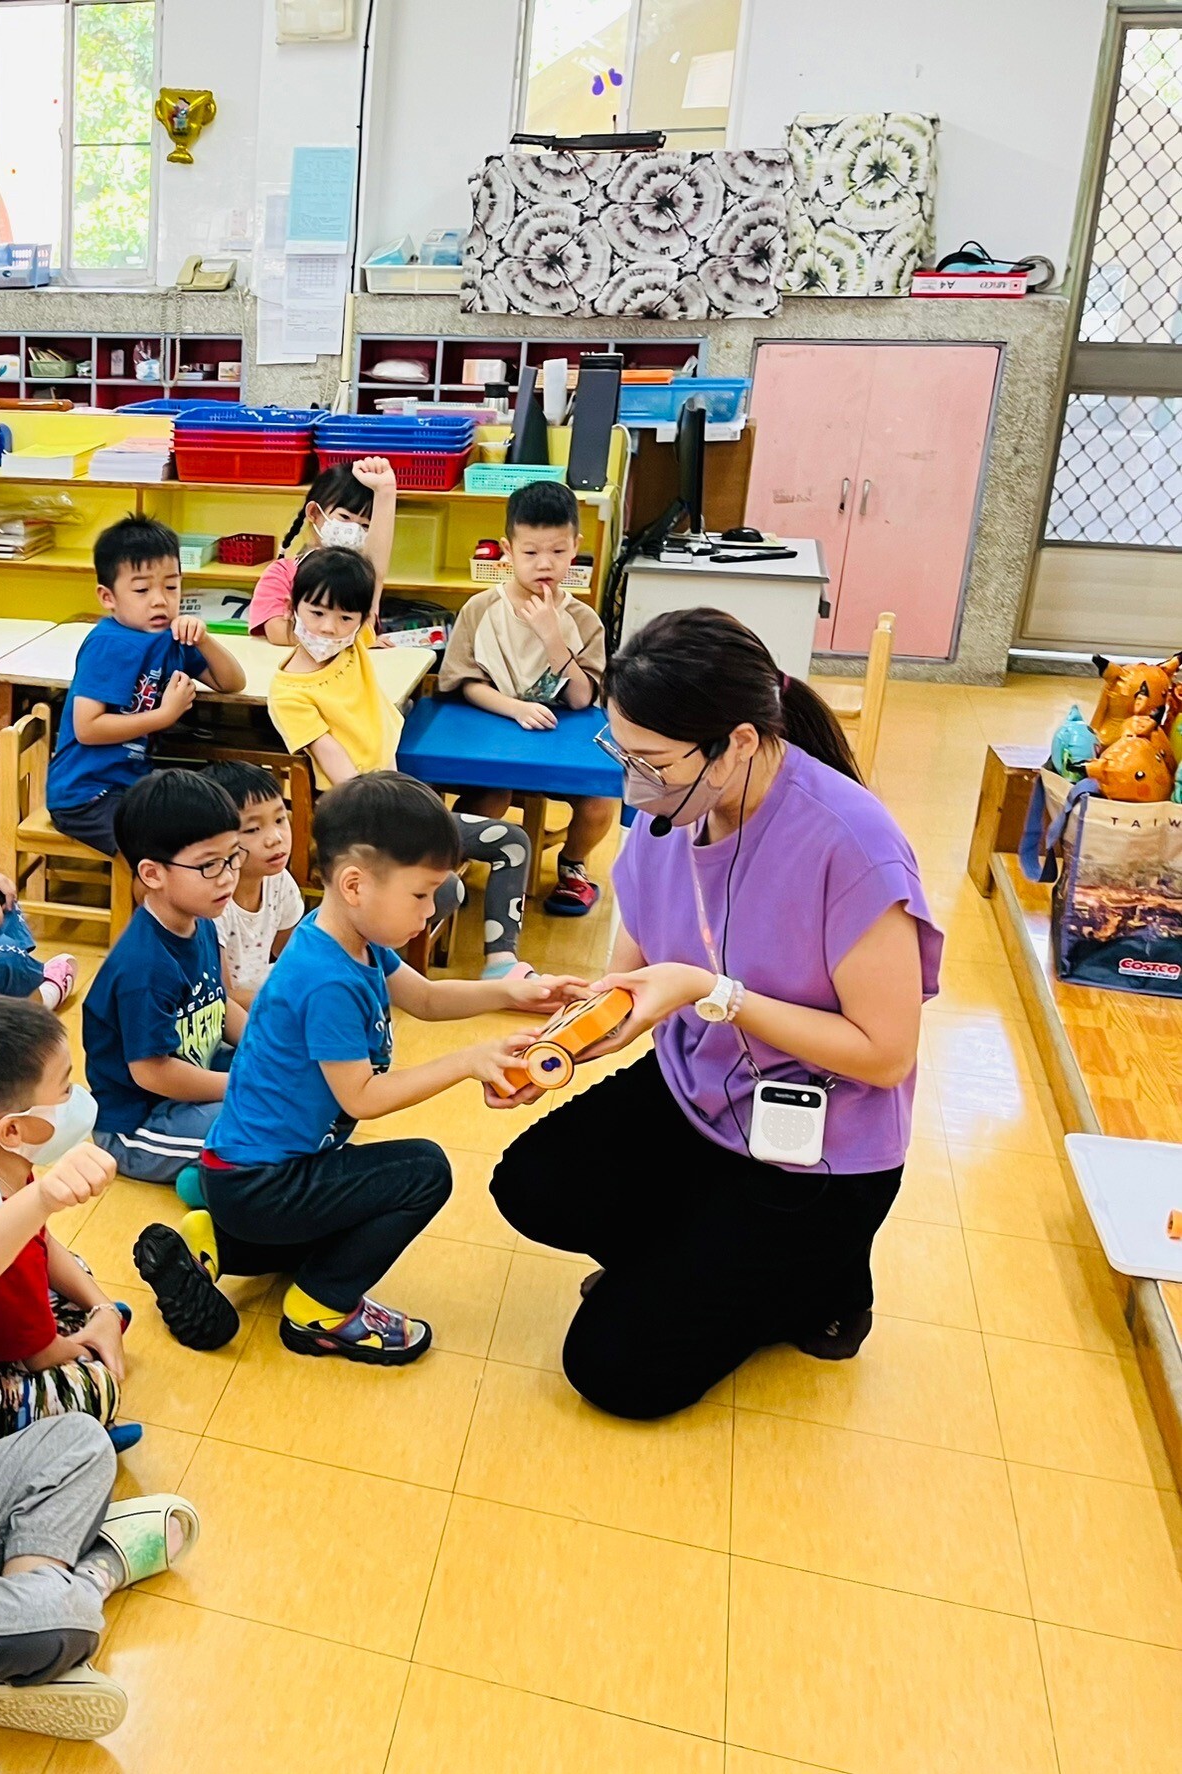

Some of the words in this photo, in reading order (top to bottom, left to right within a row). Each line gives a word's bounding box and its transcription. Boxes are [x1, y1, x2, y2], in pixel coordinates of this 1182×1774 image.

[939, 280, 956, 289] A4
[221, 595, 252, 619] 7
[1121, 959, 1180, 973] COSTCO
